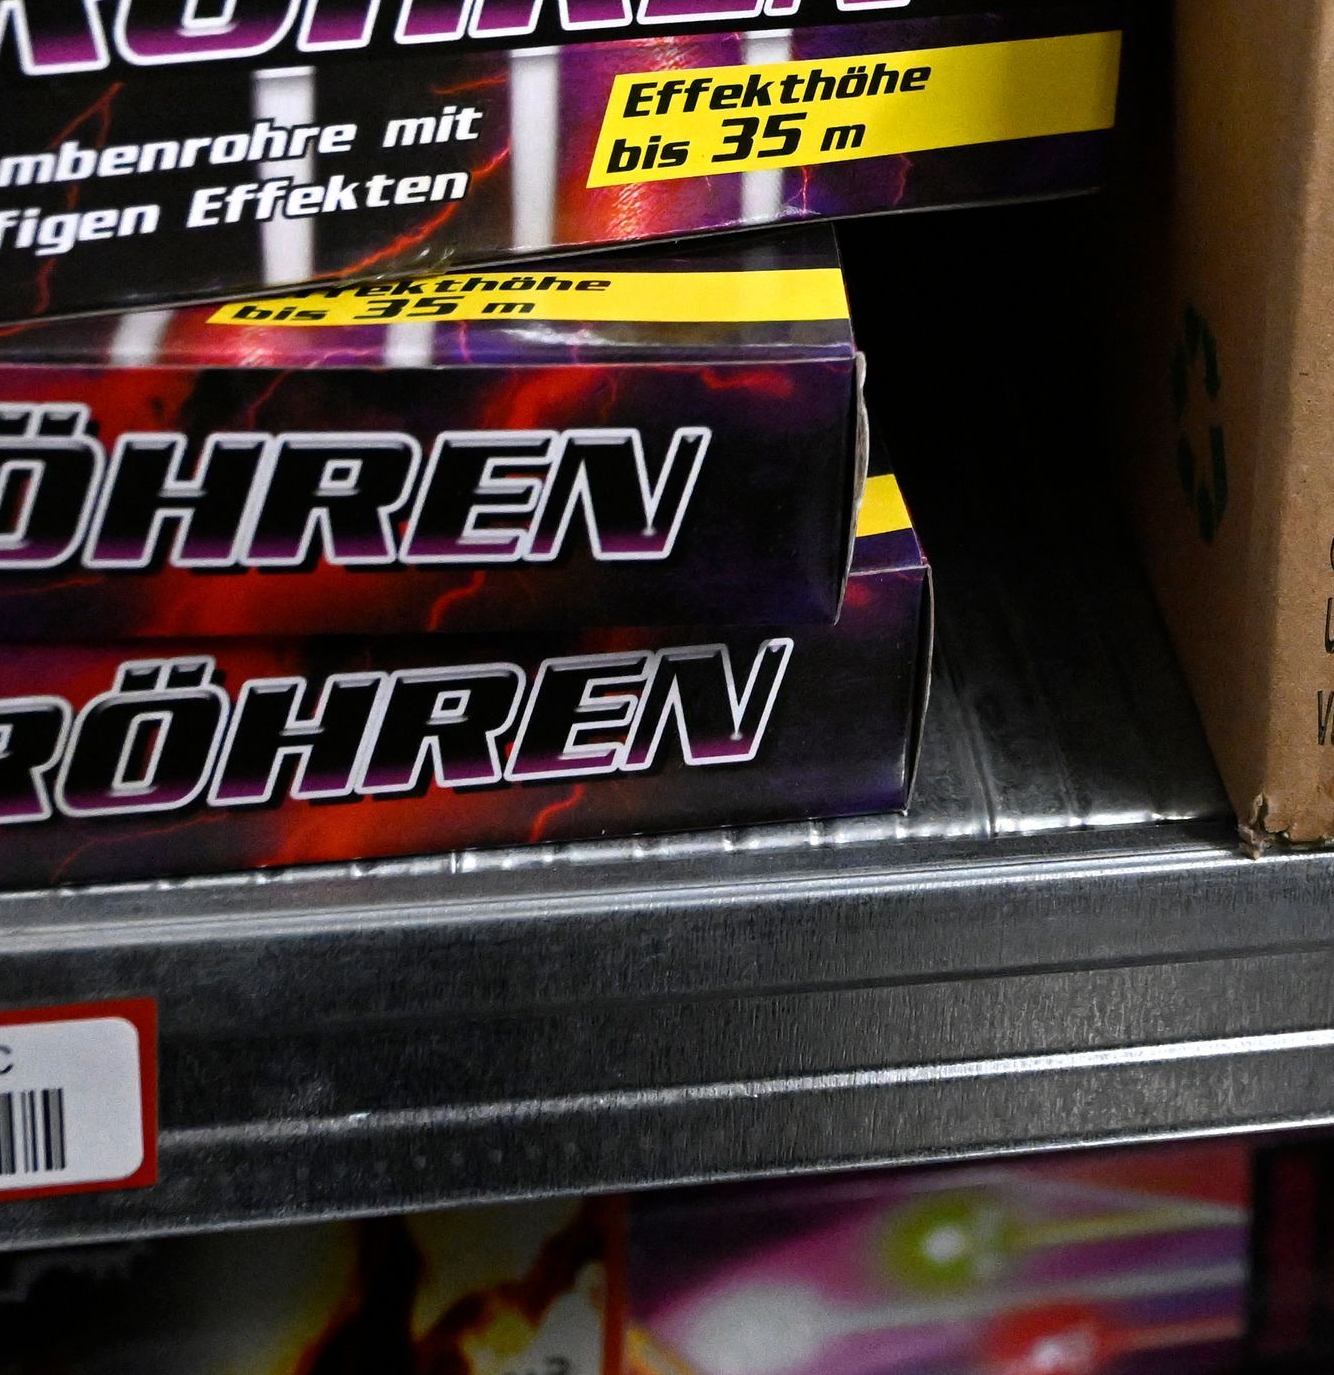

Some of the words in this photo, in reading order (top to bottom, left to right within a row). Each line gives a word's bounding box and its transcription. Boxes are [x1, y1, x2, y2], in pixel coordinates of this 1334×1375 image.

[623, 62, 932, 119] Effekthöhe
[382, 105, 484, 150] mit
[605, 136, 689, 174] bis
[710, 112, 807, 163] 35
[820, 123, 866, 153] m
[186, 171, 470, 228] Effekten
[232, 305, 329, 322] bis
[353, 296, 466, 320] 35
[481, 300, 536, 315] m
